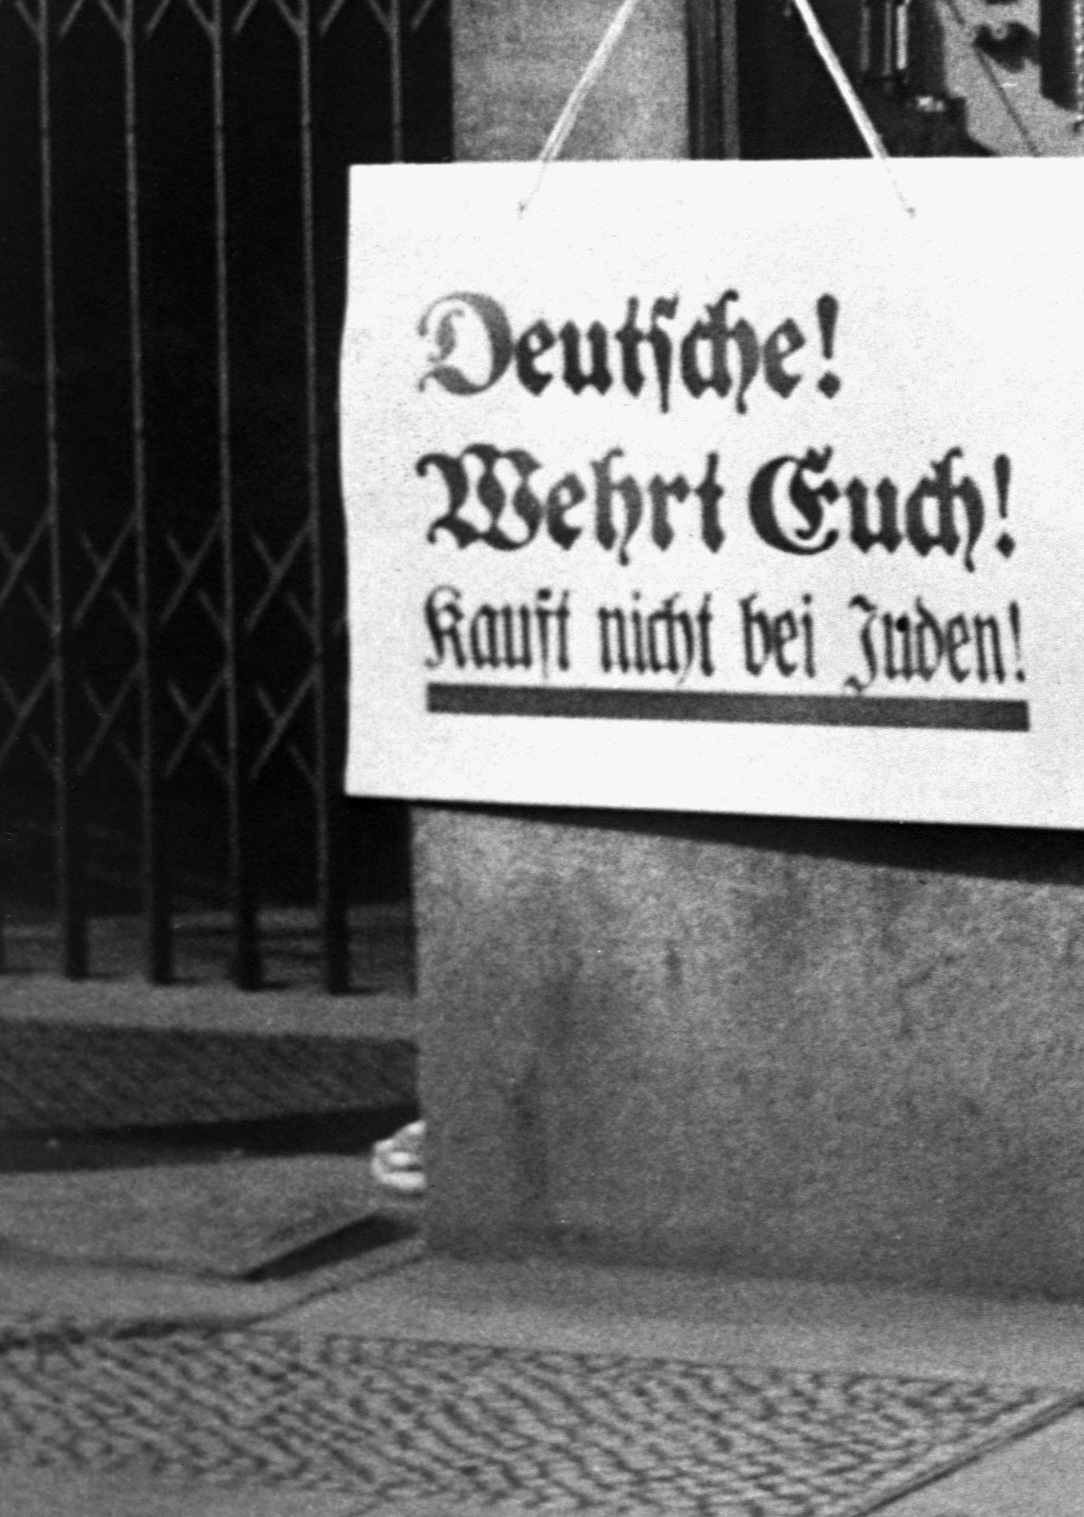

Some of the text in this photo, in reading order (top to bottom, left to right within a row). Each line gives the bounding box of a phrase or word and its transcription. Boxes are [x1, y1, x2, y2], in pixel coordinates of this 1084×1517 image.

[418, 289, 841, 414] Deutsche!
[415, 443, 1016, 573] Wehrt Euch!
[424, 585, 1026, 694] Kauft nicht bei Juden!
